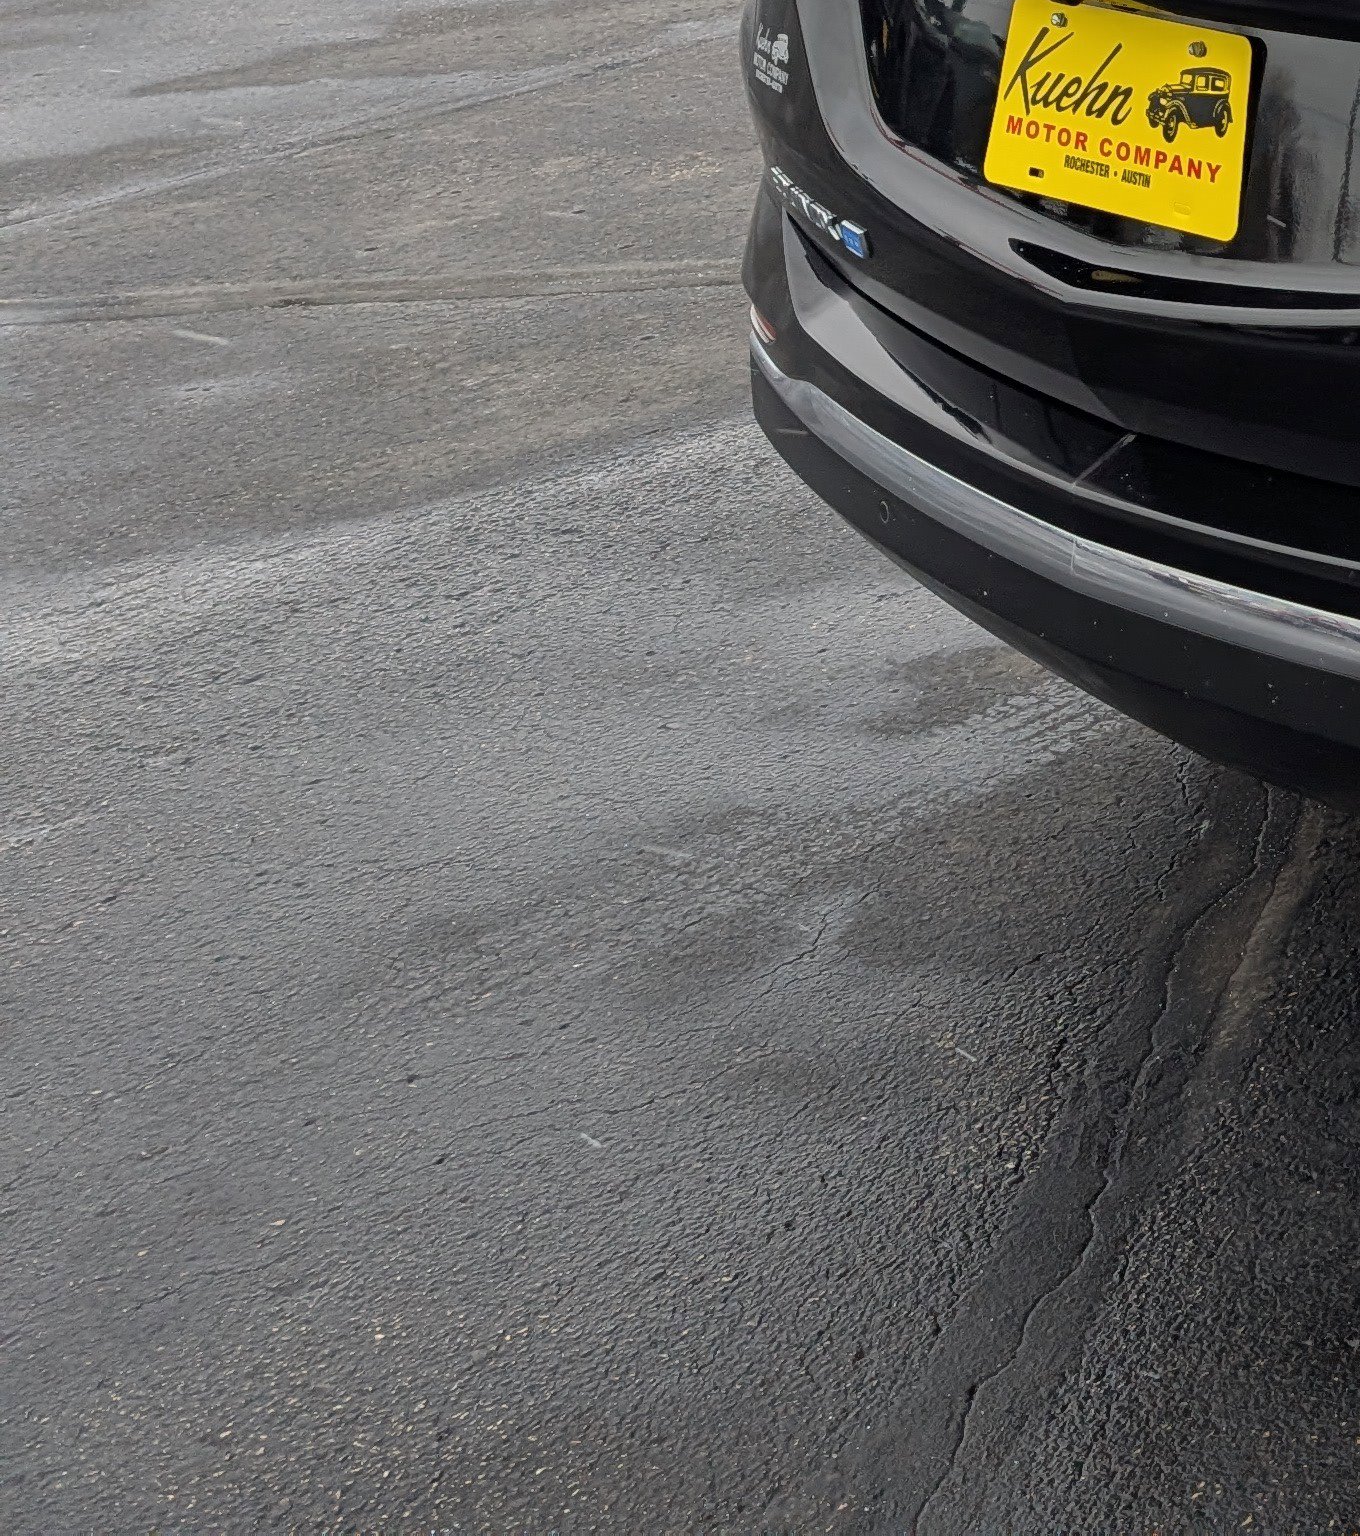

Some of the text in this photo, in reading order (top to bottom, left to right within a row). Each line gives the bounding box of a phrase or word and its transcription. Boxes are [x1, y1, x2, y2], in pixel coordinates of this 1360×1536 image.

[1003, 26, 1134, 126] Kuehn
[1006, 114, 1223, 184] MOTOR COMPANY
[1063, 154, 1151, 188] ROCHESTER AUSTIN
